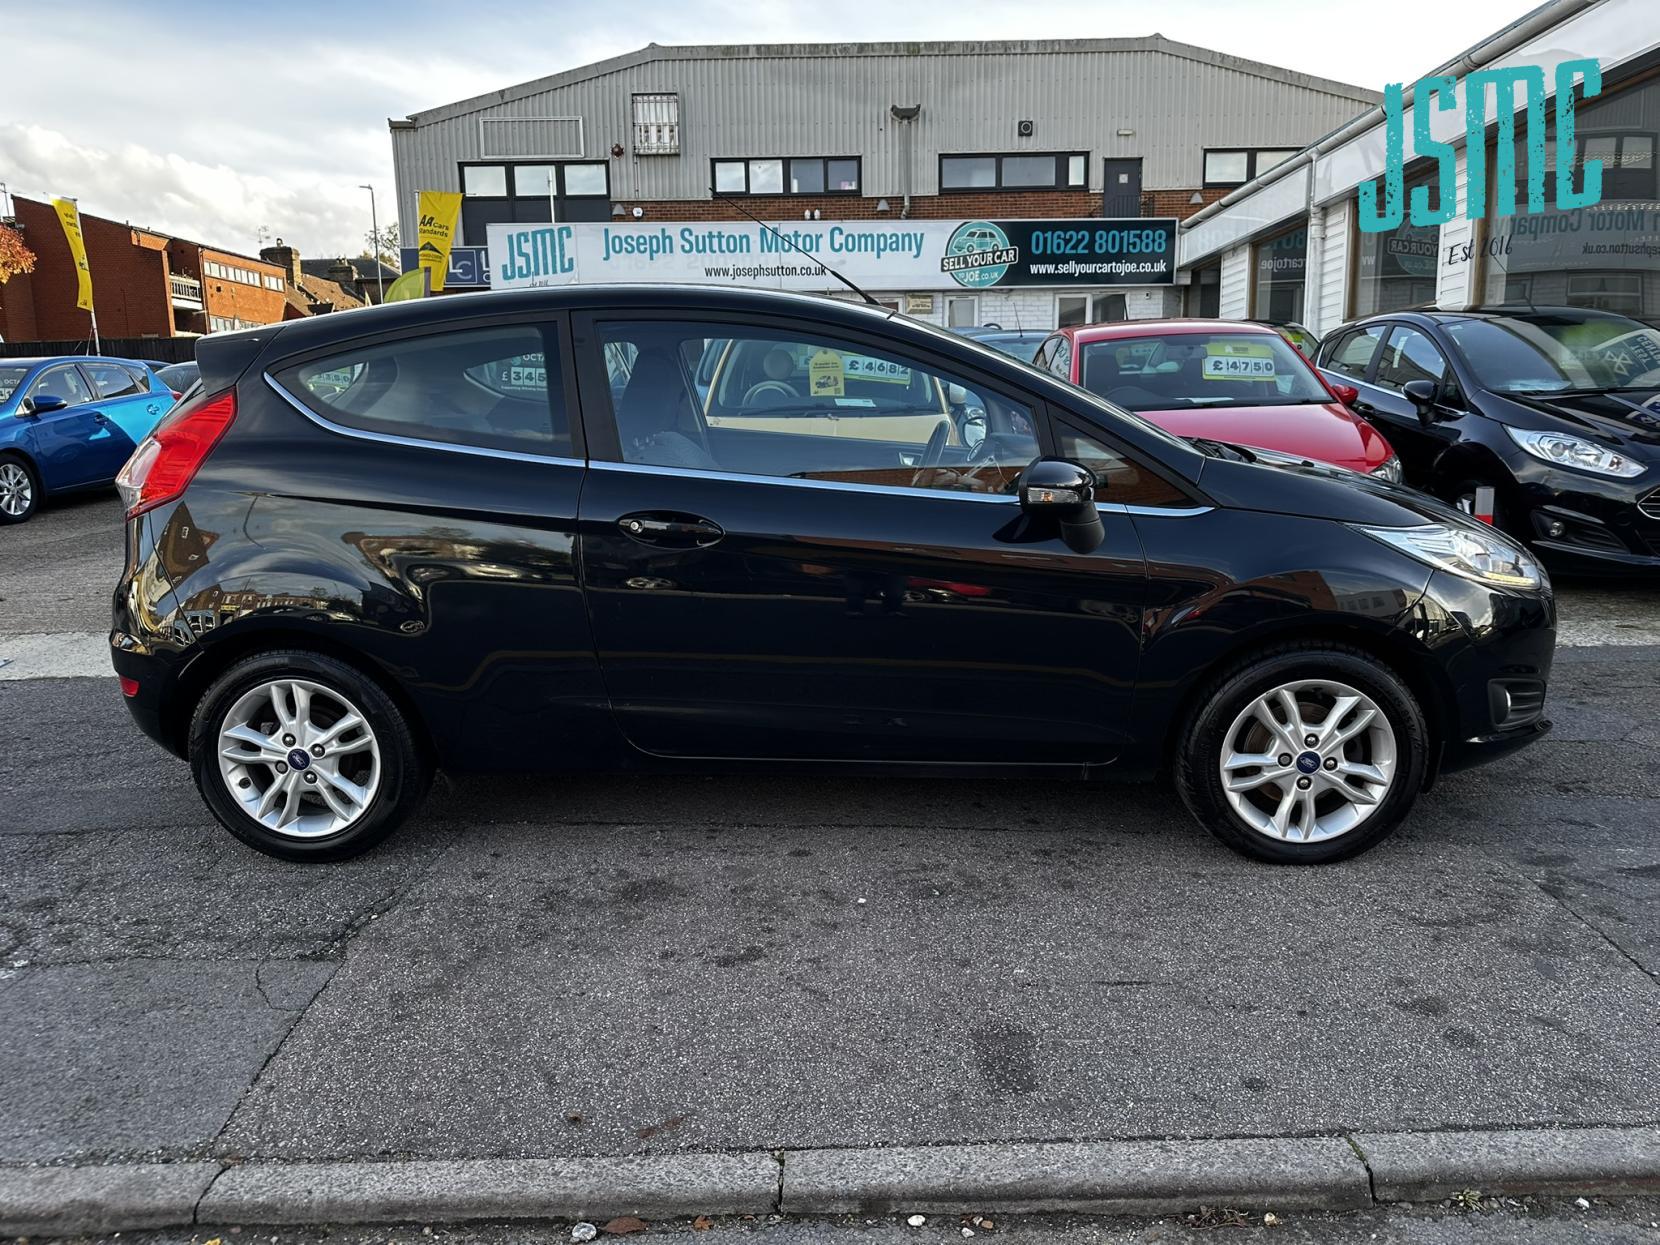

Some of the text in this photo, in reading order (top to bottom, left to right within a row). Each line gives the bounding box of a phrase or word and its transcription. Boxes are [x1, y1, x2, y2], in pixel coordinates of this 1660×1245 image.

[419, 214, 435, 227] AA
[603, 226, 925, 261] Joseph Sutton Motor Company
[1031, 229, 1167, 254] 01622 801588
[502, 226, 575, 281] JSMC
[943, 249, 1015, 271] SELL YOUR CAR
[705, 263, 828, 280] www.josephsutton.co.uk
[1030, 259, 1167, 277] www.sellyourcartojoe.co.uk
